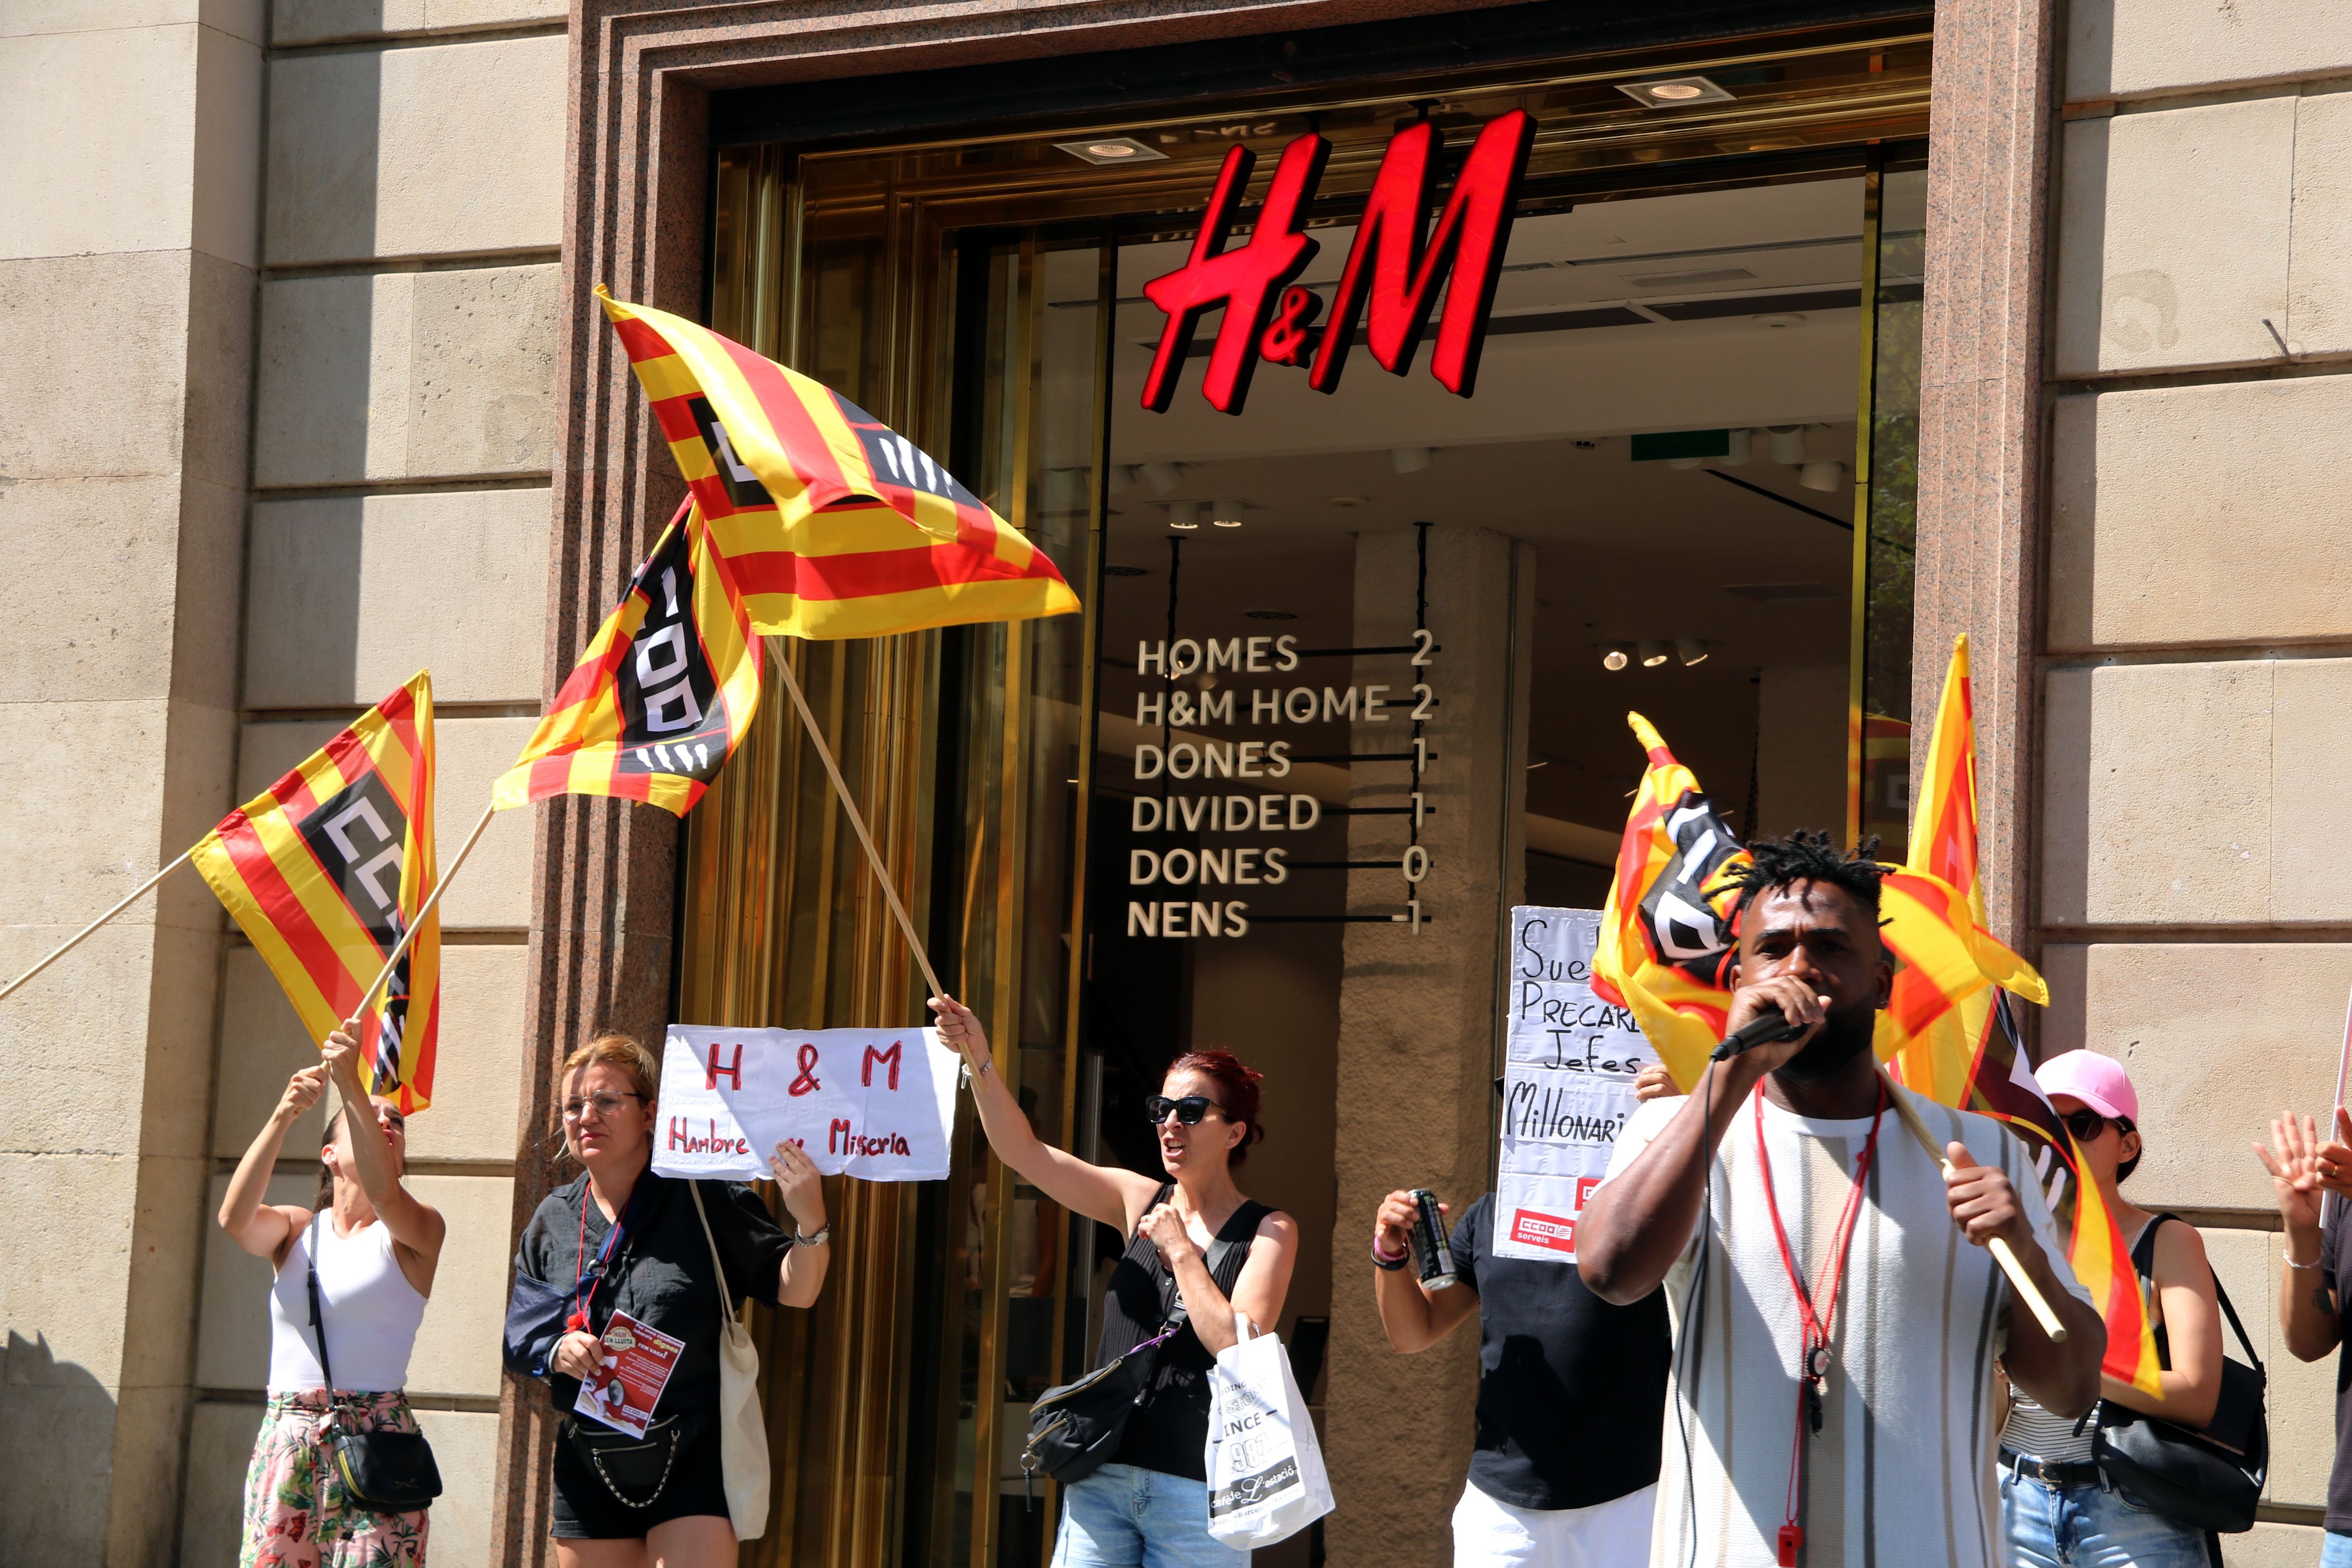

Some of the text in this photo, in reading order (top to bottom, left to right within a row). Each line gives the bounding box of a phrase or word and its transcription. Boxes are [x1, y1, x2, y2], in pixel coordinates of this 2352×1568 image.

[1141, 107, 1537, 416] H&M
[1138, 629, 1433, 675] HOMES 2
[1136, 683, 1433, 727] H&M HOME 2
[1134, 737, 1427, 780] DONES 1
[1132, 792, 1426, 832] DIVIDED 1
[1129, 845, 1430, 885] DONES 0
[1127, 900, 1250, 938] NENS
[1522, 920, 1599, 981] Sue
[1522, 981, 1640, 1032] PRECARI
[705, 1039, 902, 1097] H & M
[1544, 1030, 1641, 1073] Jefes
[829, 1118, 911, 1156] Miseria
[1517, 1232, 1550, 1244] serveis
[1522, 1221, 1555, 1234] CCOO
[638, 1342, 668, 1359] FEM VAGA!
[653, 1338, 679, 1353] dignes
[1221, 1381, 1246, 1395] EDING
[1223, 1412, 1261, 1437] INCE
[1229, 1433, 1266, 1474] 987
